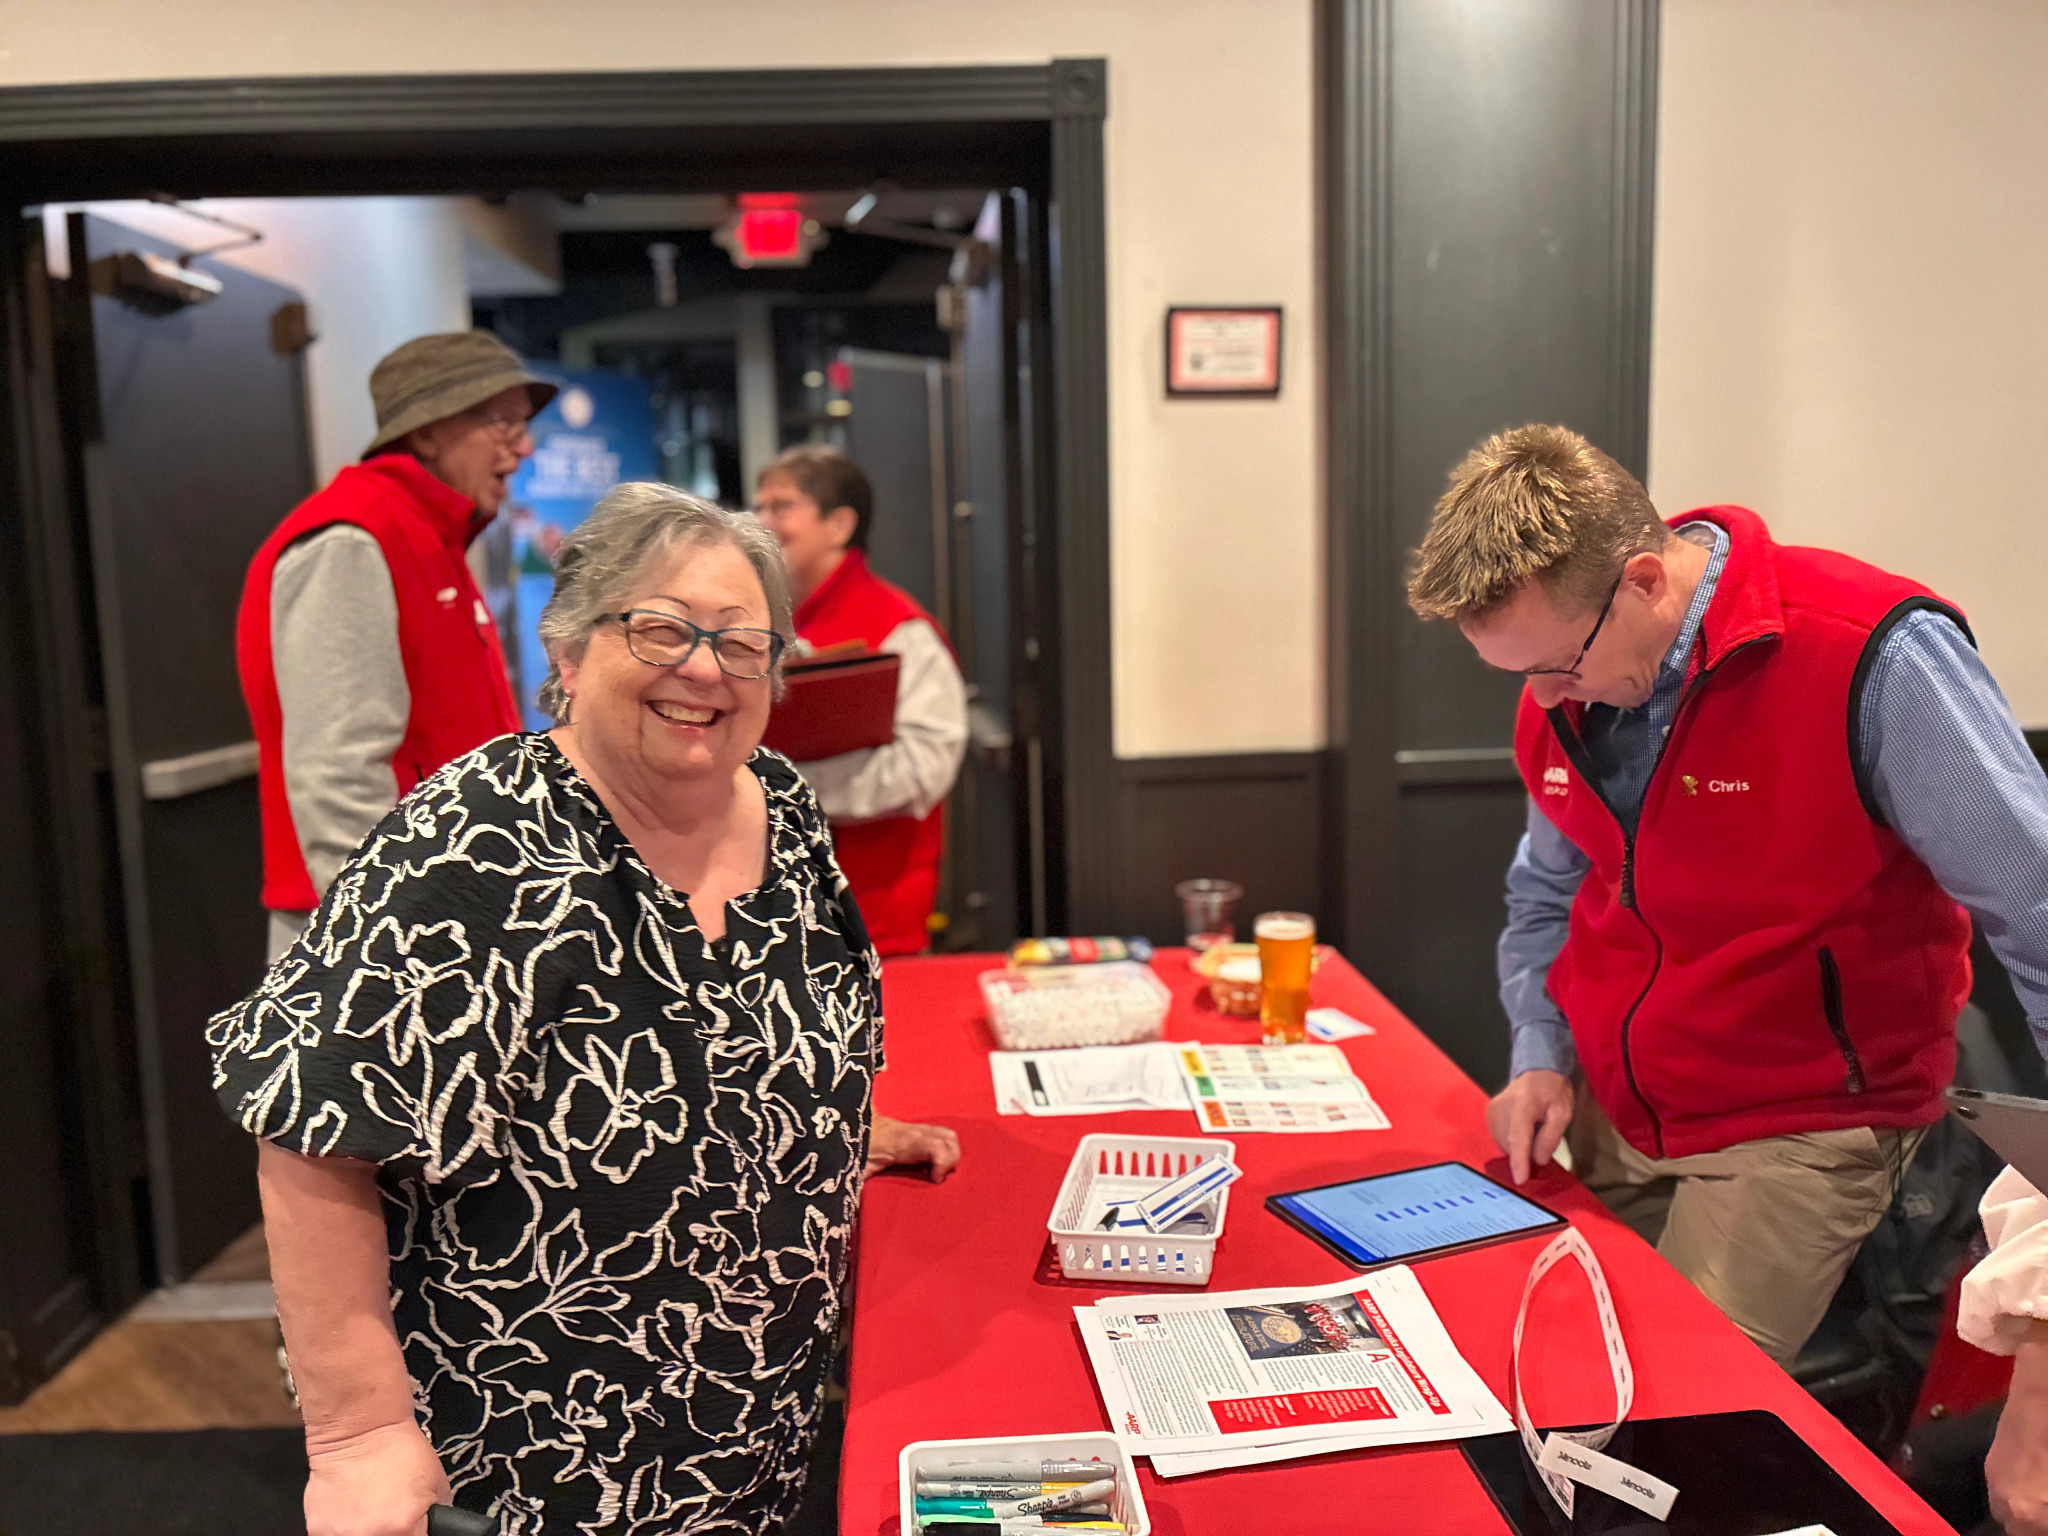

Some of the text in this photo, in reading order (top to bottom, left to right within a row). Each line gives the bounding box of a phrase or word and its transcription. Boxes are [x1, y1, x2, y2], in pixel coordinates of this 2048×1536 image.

[1709, 779, 1750, 792] Chris
[1256, 1332, 1270, 1350] STATE
[1362, 1298, 1379, 1314] AARP
[1381, 1328, 1399, 1347] Alaska
[1417, 1378, 1441, 1407] Wrap-Up
[1366, 1353, 1390, 1363] A
[1125, 1411, 1141, 1434] AARP
[1018, 1498, 1055, 1516] Sharpie
